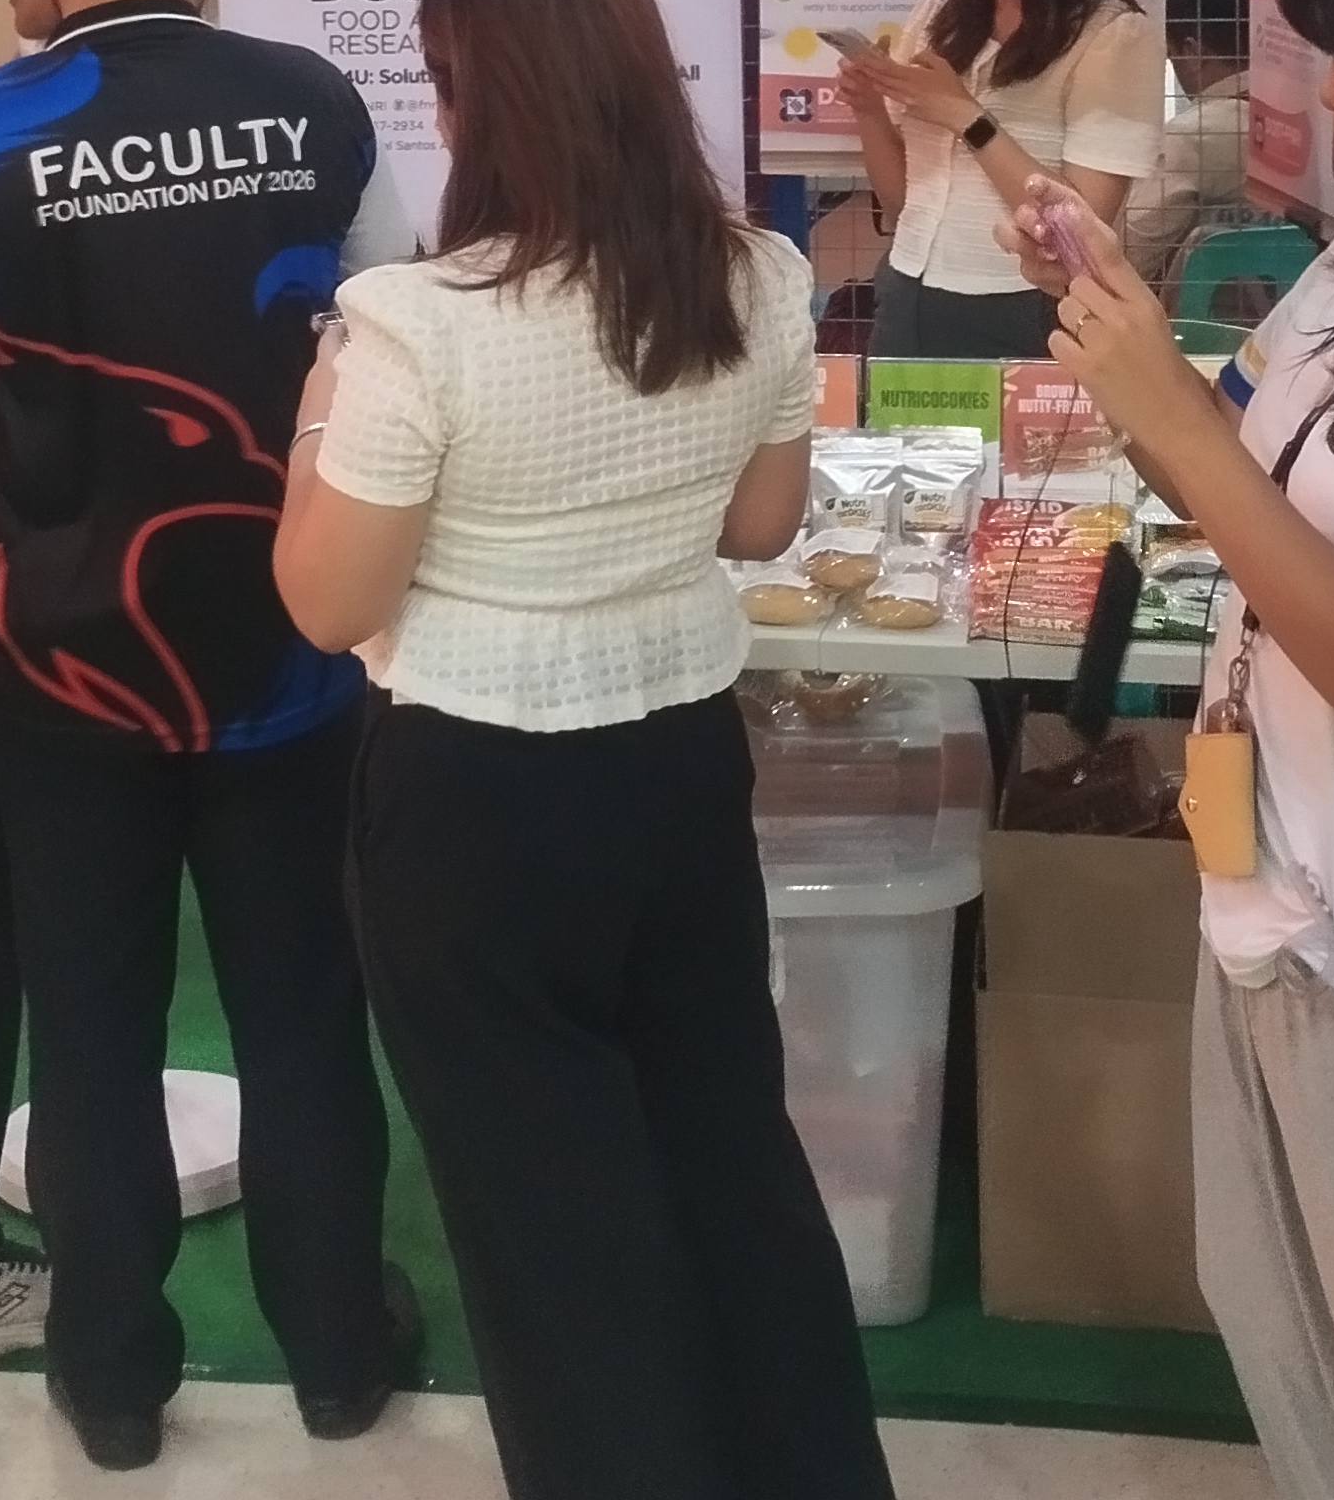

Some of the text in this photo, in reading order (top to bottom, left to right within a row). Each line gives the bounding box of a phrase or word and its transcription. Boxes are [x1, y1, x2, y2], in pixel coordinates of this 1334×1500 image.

[322, 9, 401, 31] FOOD
[29, 117, 309, 197] FACULTY
[395, 140, 436, 151] Santos
[36, 168, 317, 227] FOUNDATION DAY 2026
